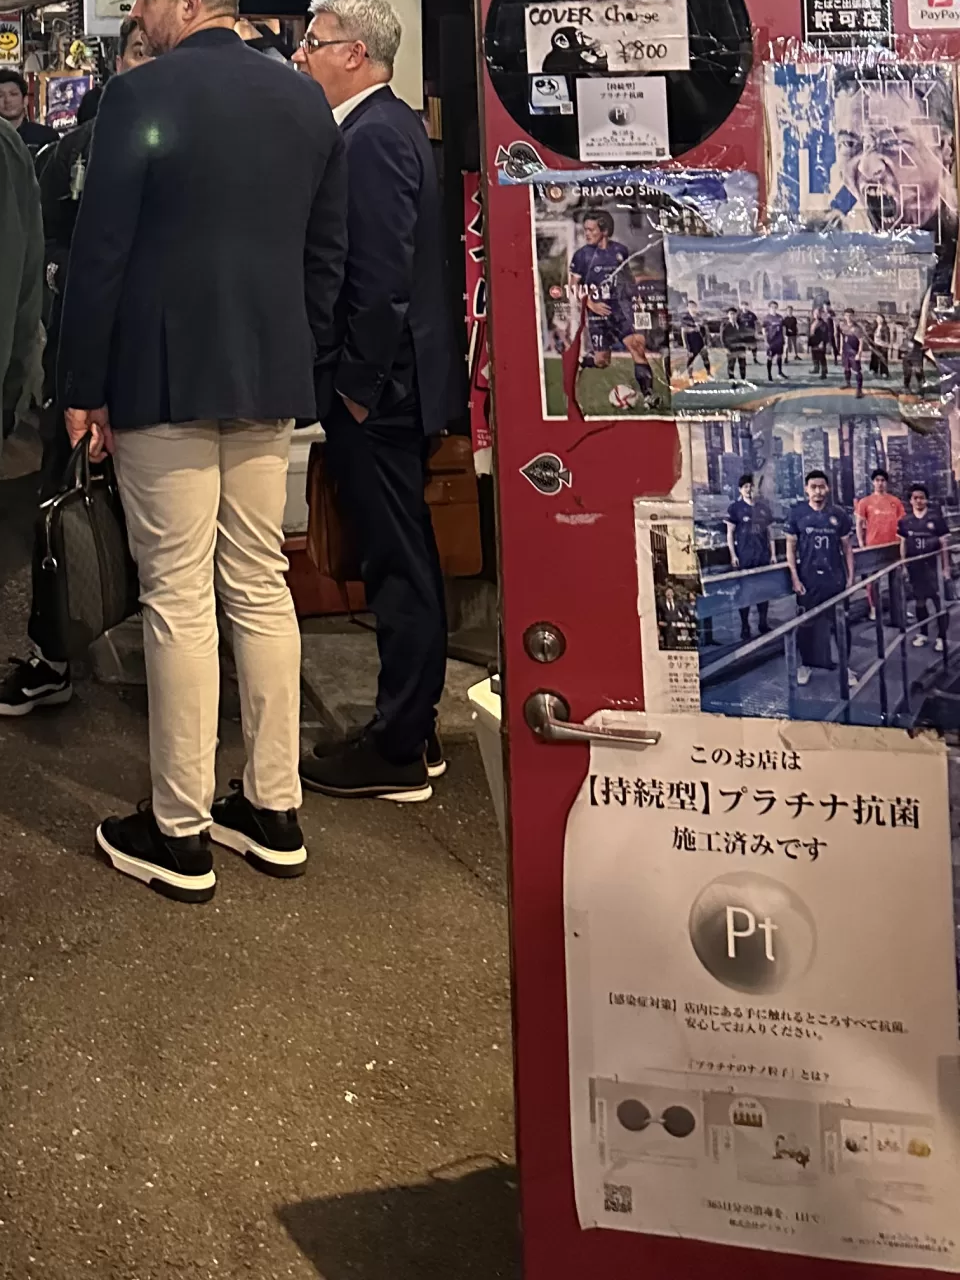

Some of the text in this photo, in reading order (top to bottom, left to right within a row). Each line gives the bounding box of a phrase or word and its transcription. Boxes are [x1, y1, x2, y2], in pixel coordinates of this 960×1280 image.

[529, 4, 659, 28] COVER Charge
[813, 10, 882, 31] 許可店
[920, 8, 960, 21] PayPay
[617, 39, 668, 64] ¥800
[571, 185, 635, 197] CRIACAO
[813, 535, 829, 550] 37
[914, 538, 926, 550] 31
[690, 744, 802, 771] このお店は
[589, 774, 920, 830] 【持続型】プラチナ抗菌
[672, 825, 828, 862] 施工済みです
[726, 905, 779, 961] Pt
